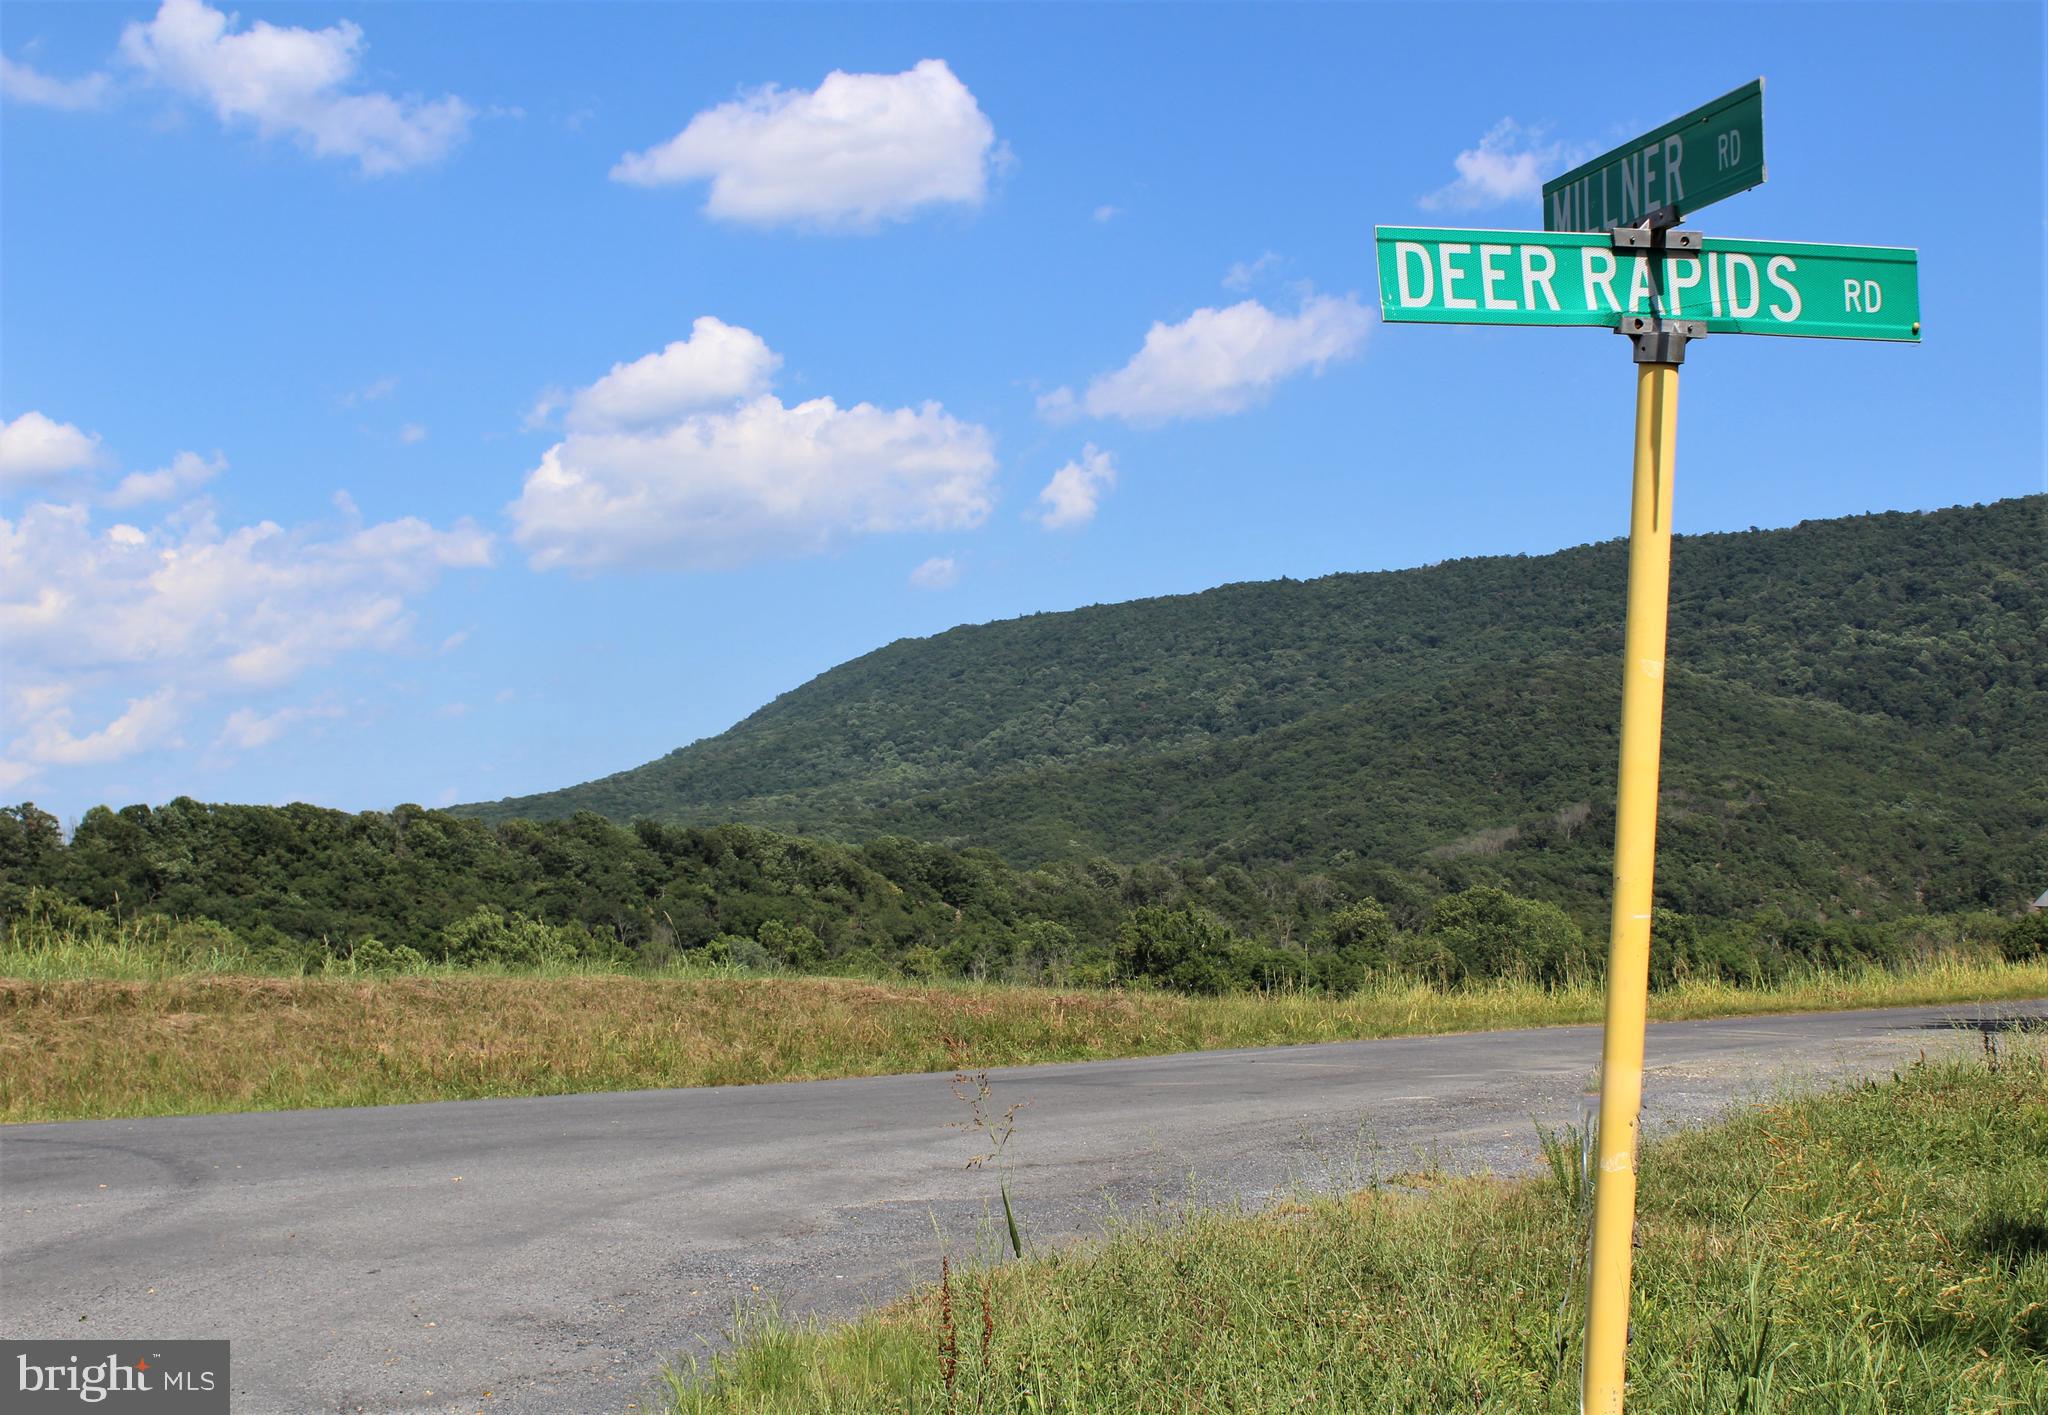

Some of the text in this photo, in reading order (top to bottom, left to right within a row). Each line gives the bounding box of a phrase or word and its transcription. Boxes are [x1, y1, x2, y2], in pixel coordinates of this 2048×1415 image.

[1553, 129, 1741, 232] MILLNER RD
[1396, 241, 1882, 322] DEER RAPIDS RD
